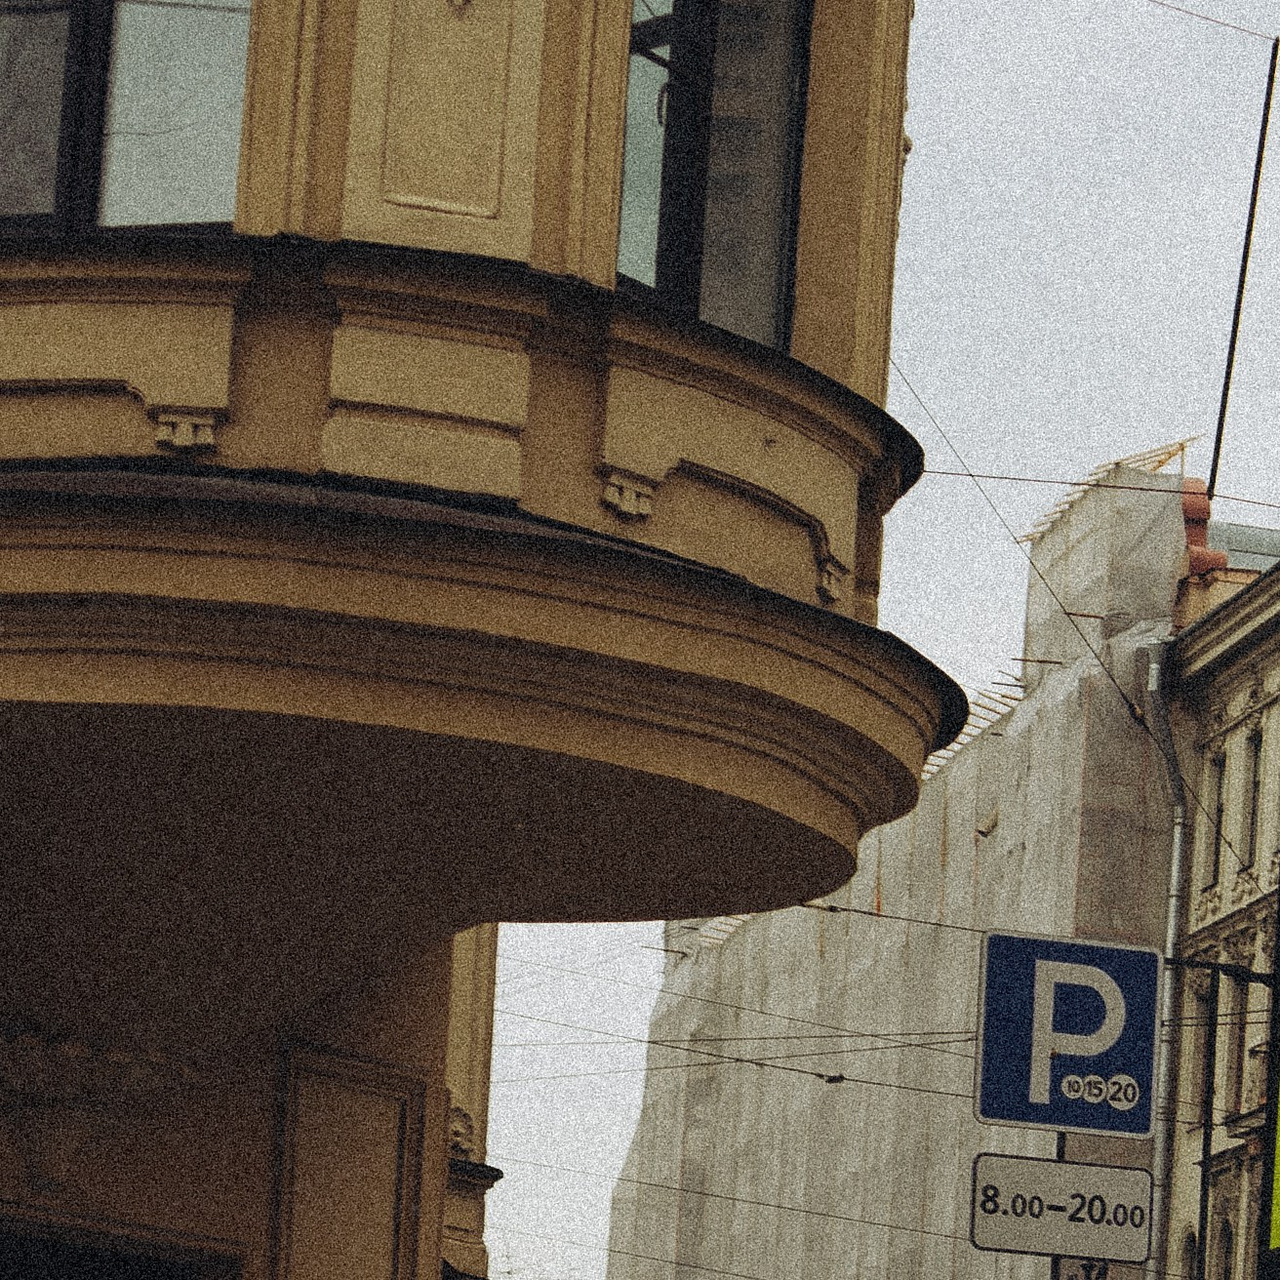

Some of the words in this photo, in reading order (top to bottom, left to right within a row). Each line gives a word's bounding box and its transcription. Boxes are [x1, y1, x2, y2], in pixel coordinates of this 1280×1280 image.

[1028, 958, 1127, 1106] P
[1066, 1079, 1082, 1094] 10
[1086, 1080, 1104, 1098] 15
[1109, 1081, 1137, 1104] 20
